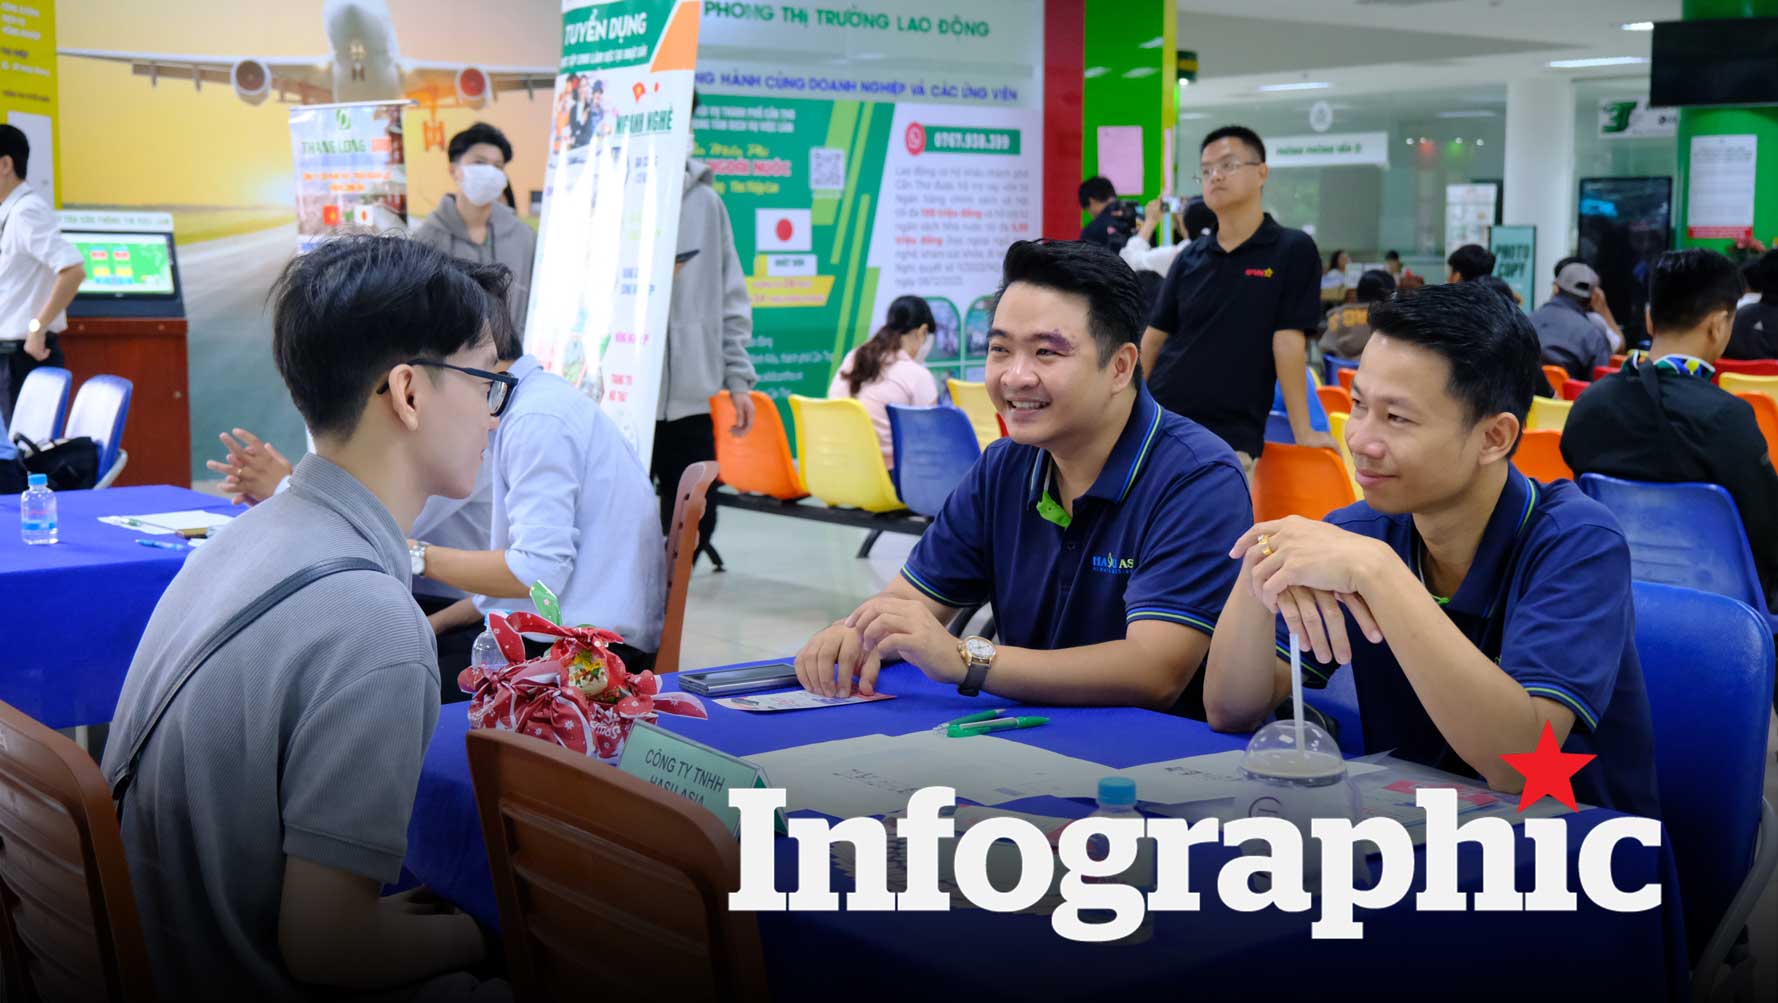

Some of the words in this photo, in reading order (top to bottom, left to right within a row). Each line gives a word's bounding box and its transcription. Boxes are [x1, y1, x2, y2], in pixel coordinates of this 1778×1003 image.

[564, 8, 607, 45] TUYỂN
[608, 12, 647, 43] DỤNG
[897, 17, 931, 33] LAO
[644, 748, 677, 773] CÔNG
[678, 760, 693, 779] TY
[694, 768, 726, 793] TNHH
